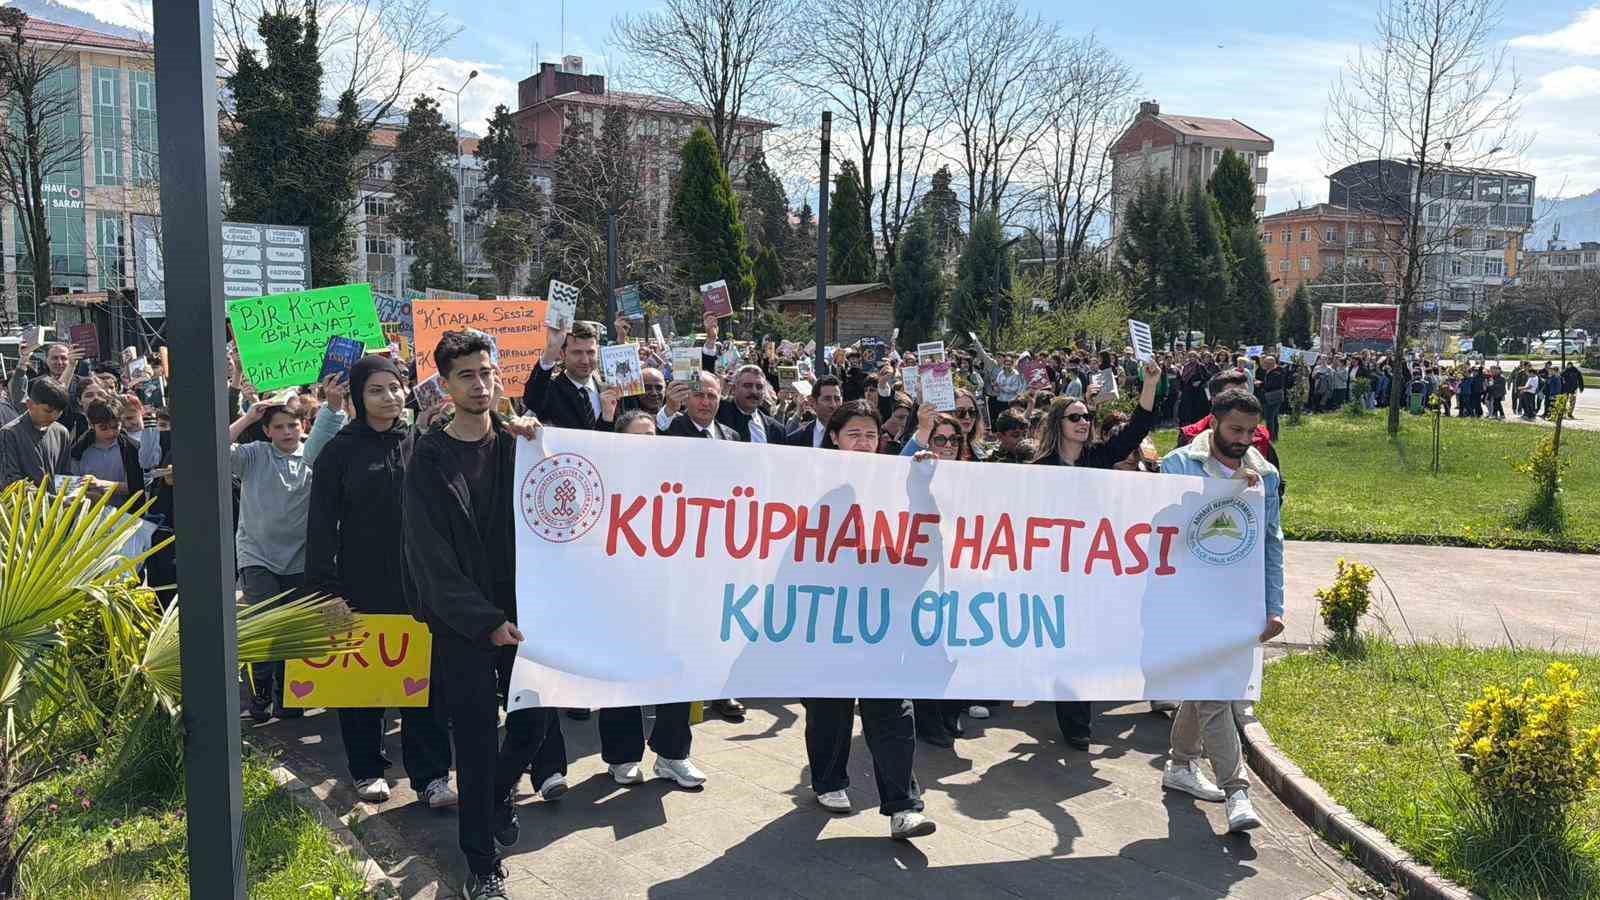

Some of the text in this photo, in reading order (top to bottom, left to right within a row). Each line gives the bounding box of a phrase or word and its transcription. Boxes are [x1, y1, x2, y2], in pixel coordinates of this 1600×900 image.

[52, 200, 84, 208] SARAYI
[288, 295, 353, 322] KİTAP
[261, 314, 356, 344] BİN HAYAT
[246, 362, 278, 385] BİR
[606, 482, 940, 566] KÜTÜPHANE
[950, 513, 1179, 576] HAFTASI
[720, 584, 1066, 649] KUTLU OLSUN
